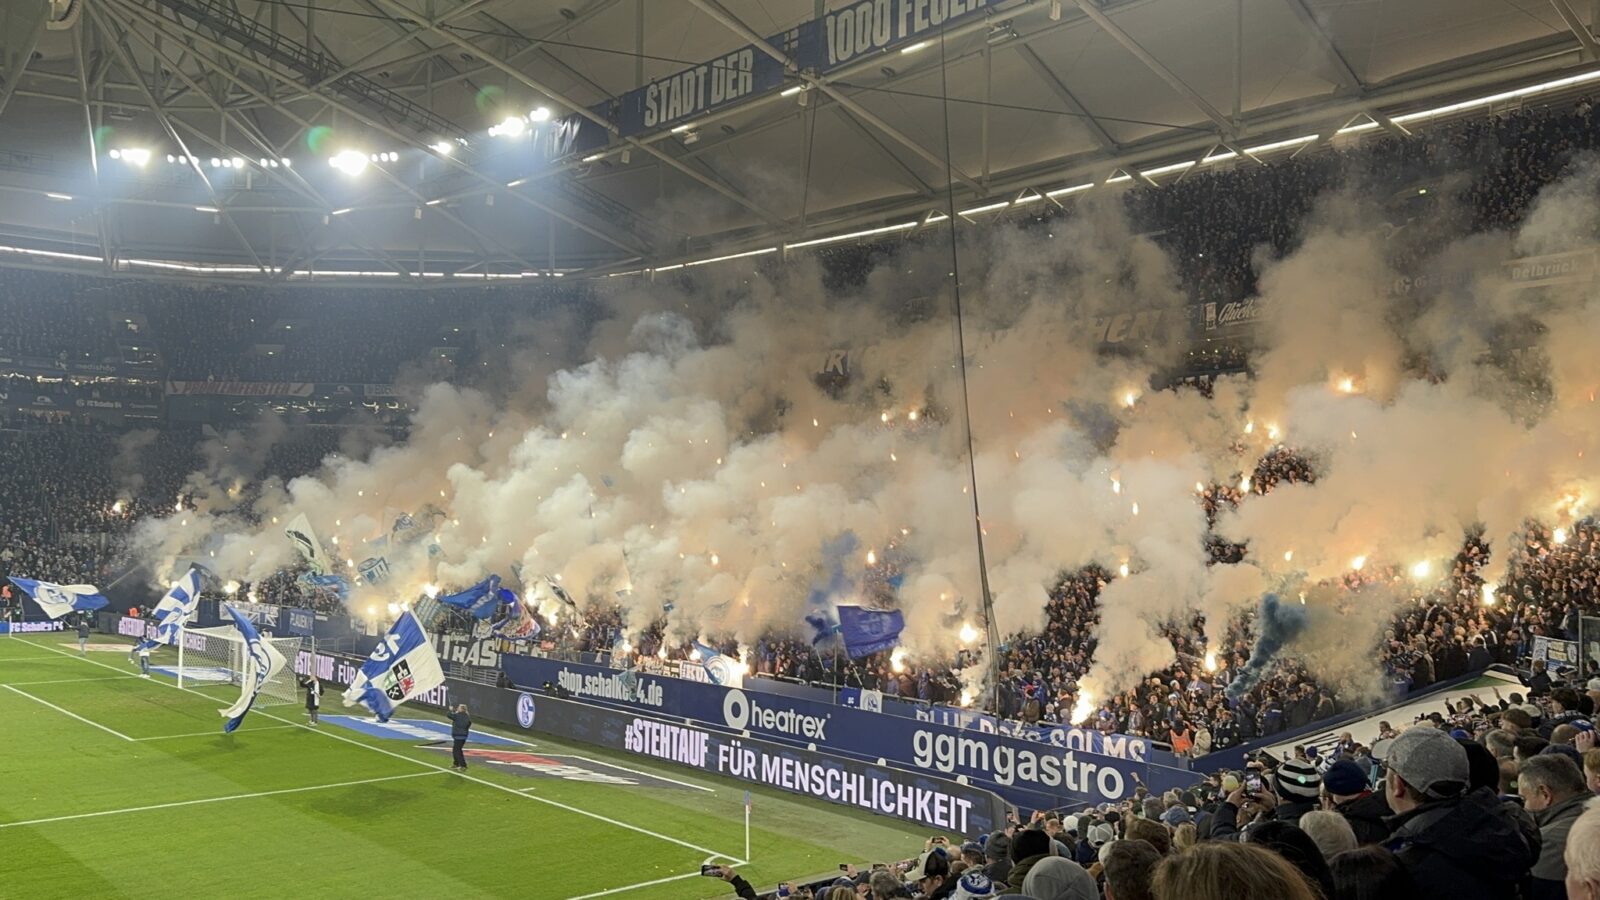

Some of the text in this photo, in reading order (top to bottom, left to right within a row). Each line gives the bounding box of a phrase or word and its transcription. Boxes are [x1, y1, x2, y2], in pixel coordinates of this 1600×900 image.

[643, 0, 987, 128] STADT DER 1000 FEU
[557, 667, 664, 707] shop.schalke4.de
[752, 700, 827, 740] heatrex
[624, 717, 710, 768] #STEHTAUF
[718, 741, 757, 784] FÜR
[761, 754, 973, 834] MENSCHLICHKEIT
